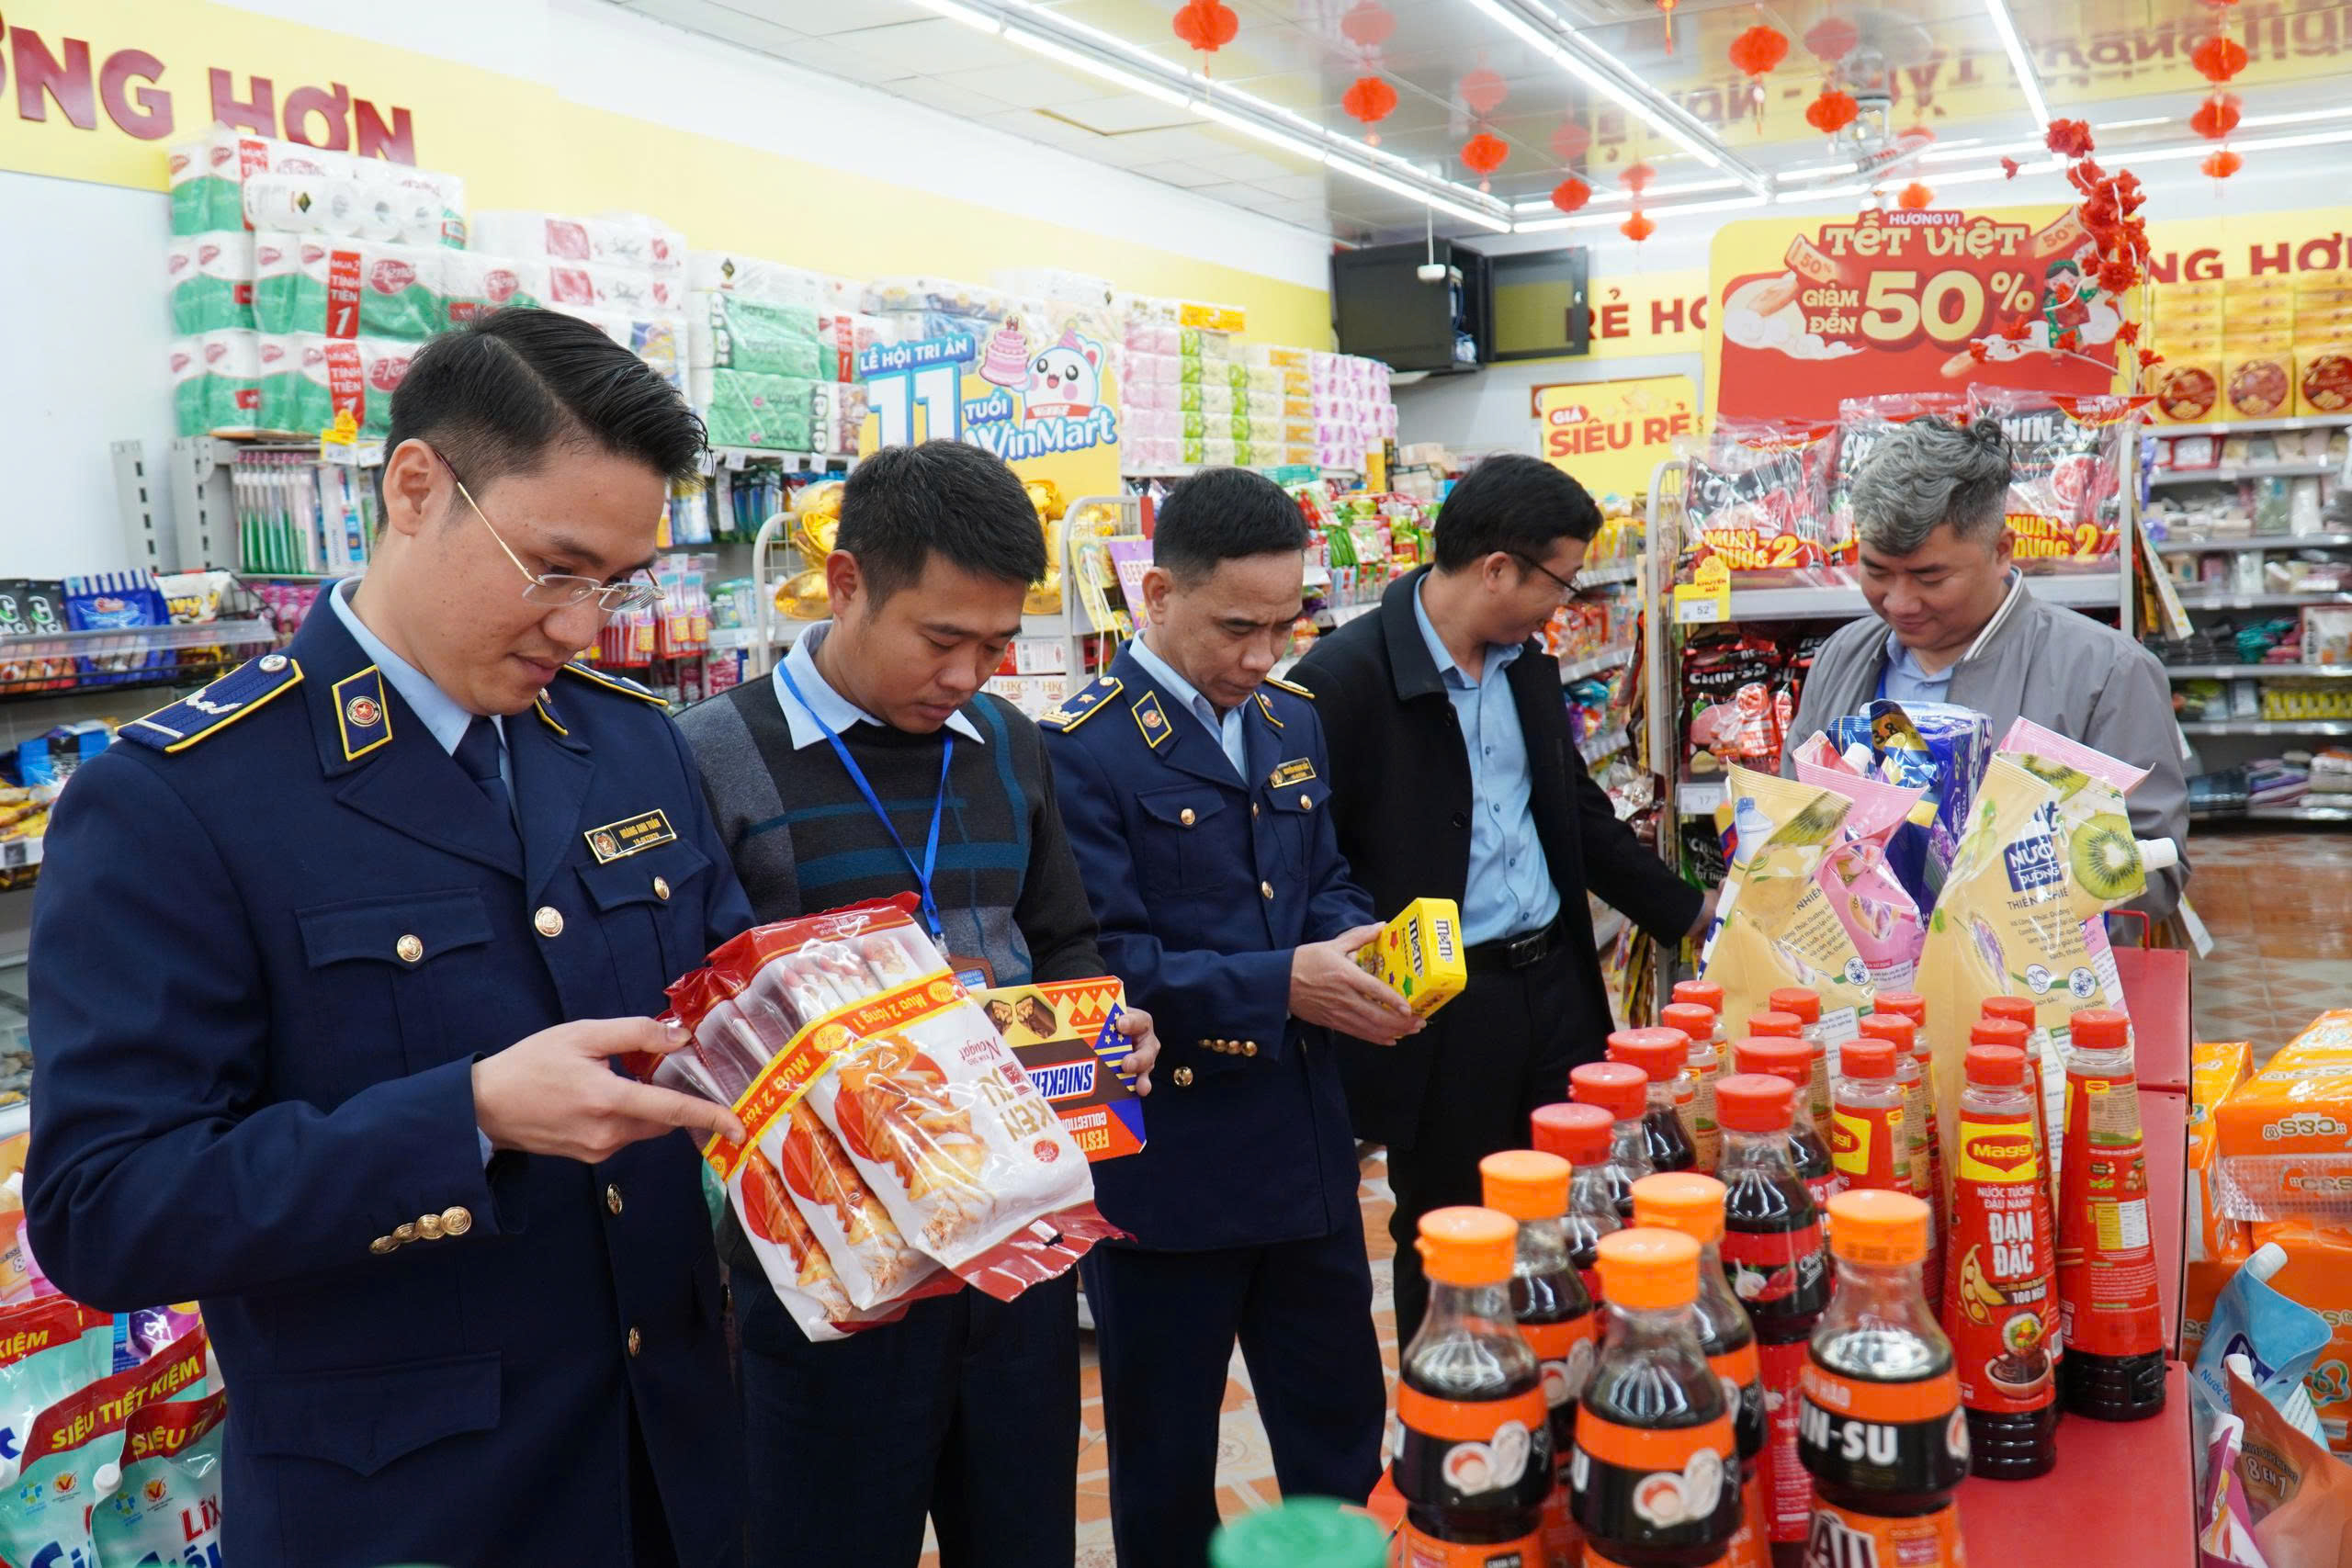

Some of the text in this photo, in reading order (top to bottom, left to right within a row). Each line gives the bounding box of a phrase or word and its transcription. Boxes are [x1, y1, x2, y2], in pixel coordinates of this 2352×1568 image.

[0, 5, 175, 140] NG
[1889, 211, 1961, 227] HƯƠNG VỊ
[2251, 232, 2352, 275] HƠ
[1861, 269, 2035, 344] 50%
[882, 345, 911, 369] HỘI
[914, 343, 940, 361] TRI
[944, 336, 968, 357] ÂN
[867, 366, 956, 449] 11
[965, 392, 1008, 420] TUỔI
[1552, 404, 1584, 425] GIÁ
[965, 410, 1116, 461] WinMart
[1549, 402, 1692, 457] SIÊU RẺ
[1989, 1210, 2033, 1246] ĐẬM
[1994, 1239, 2035, 1279] ĐẶC
[51, 1355, 201, 1450] SIÊU TIẾT KIỆM
[131, 1427, 187, 1457] SIÊU
[1800, 1395, 1898, 1467] IN-SU
